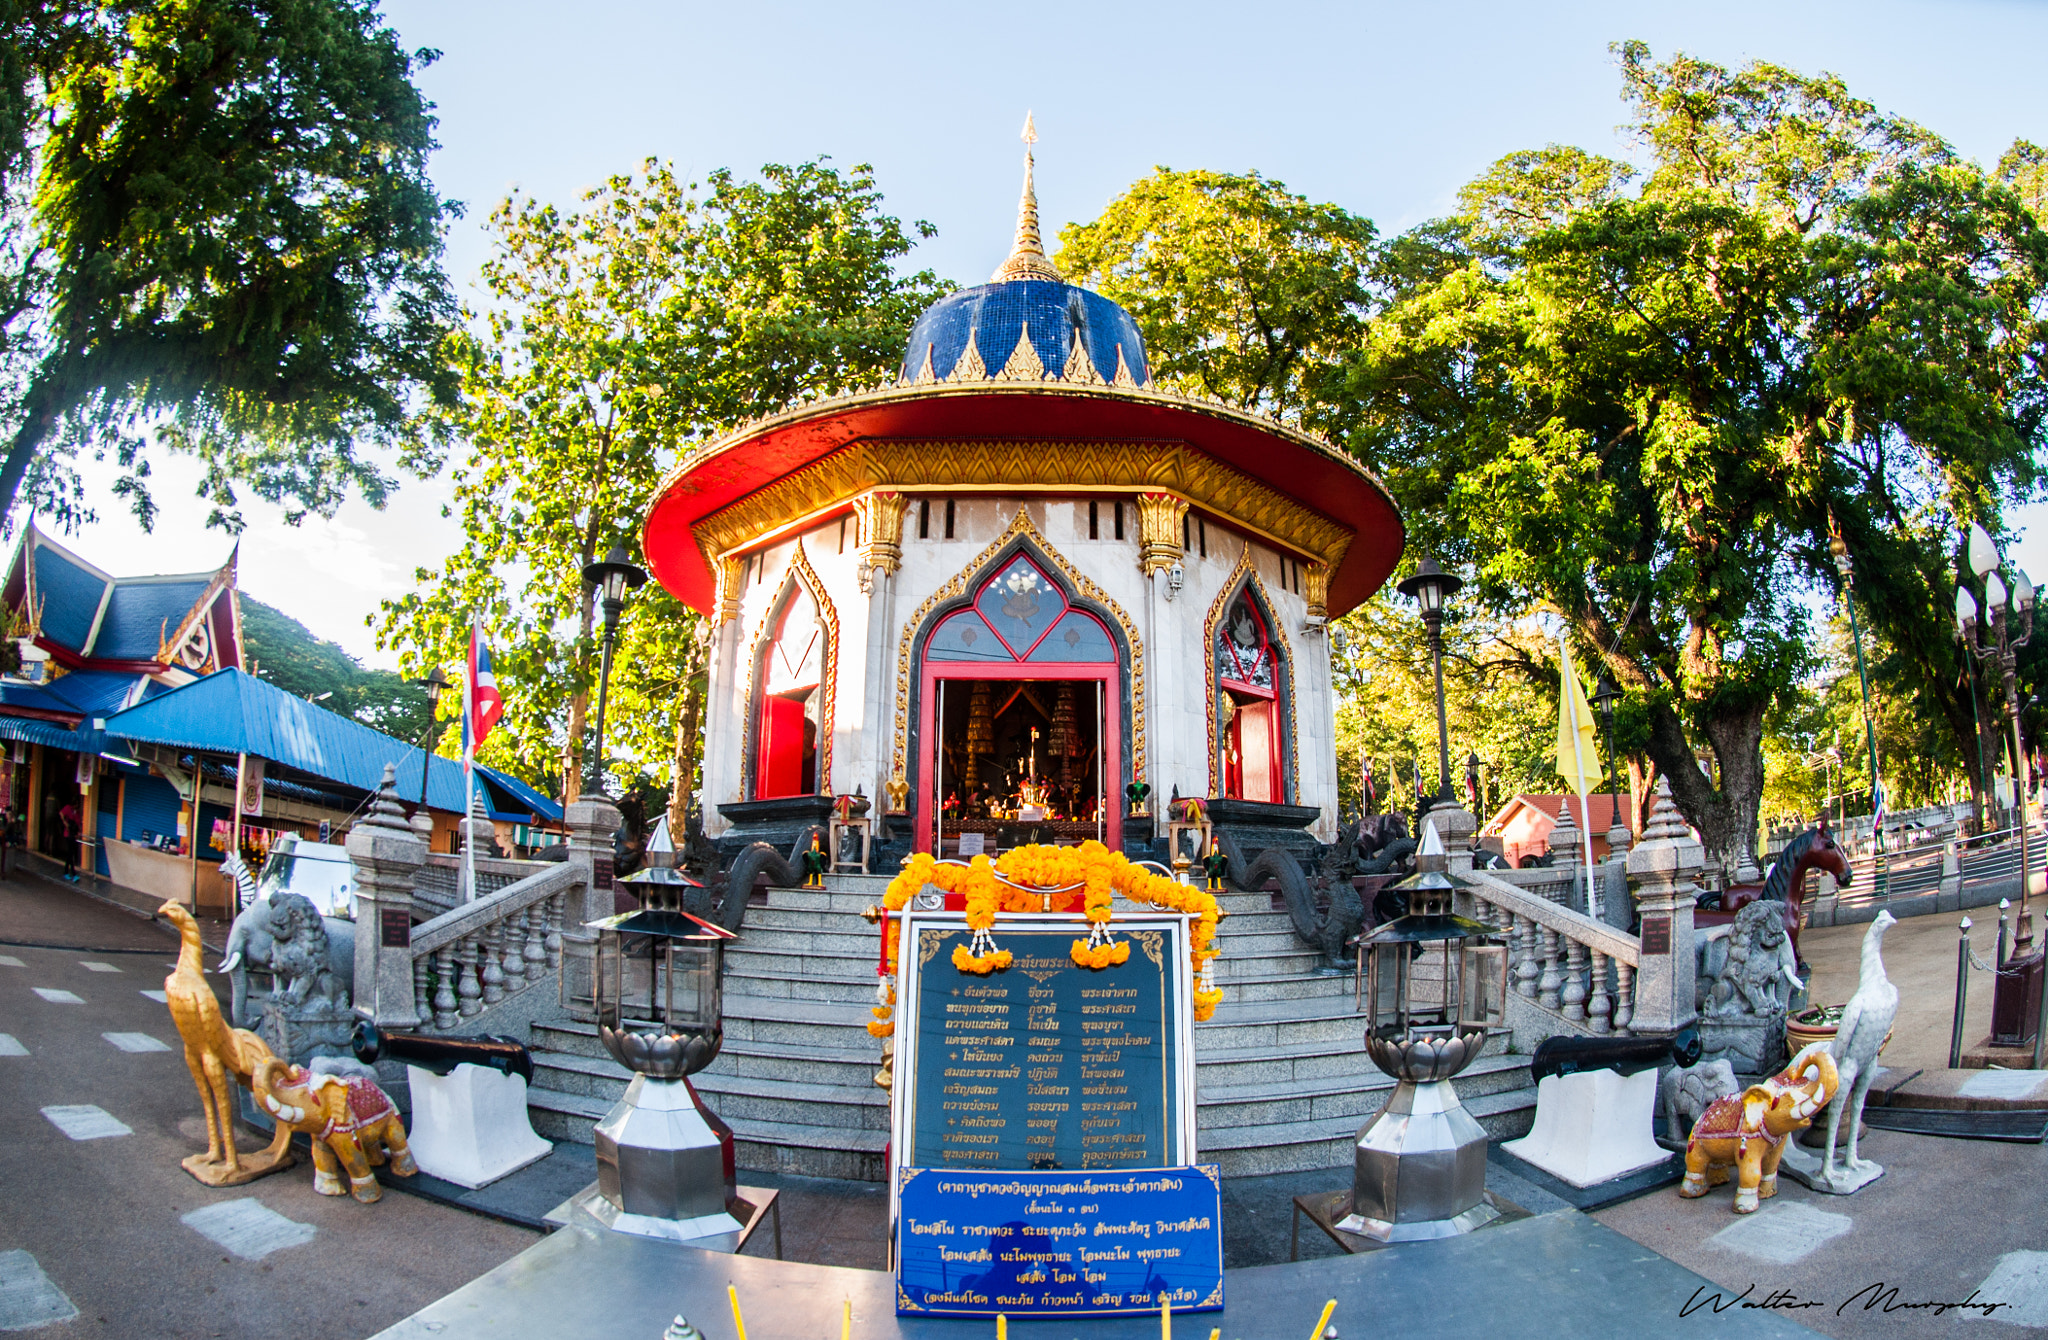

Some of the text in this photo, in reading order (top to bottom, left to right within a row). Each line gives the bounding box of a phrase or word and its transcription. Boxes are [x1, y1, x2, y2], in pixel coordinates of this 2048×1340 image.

[1028, 983, 1054, 998] ชื่อว่า
[1081, 983, 1138, 998] พระเจ้าตาก
[1028, 999, 1057, 1015] กู้ชาติ
[1081, 1004, 1136, 1014] พระศาสนา
[945, 1014, 1124, 1033] ถวายแผ่นดิน ให้เป็น พุทธบูชา
[1027, 1036, 1061, 1047] สมณะ
[1081, 1033, 1151, 1049] พระพุทธโคดม
[1027, 1048, 1063, 1063] คงถ้วน
[1081, 1048, 1120, 1062] ห้าพันปี
[1027, 1067, 1058, 1081] ปฏิบัติ
[943, 1081, 1128, 1097] เจริญสมถะ วิปัสสนา พ่อชื่นชม
[943, 1099, 1137, 1112] ถวายบังคม รอยบาท พระศาสดา
[960, 1112, 1120, 1130] คิดถึงพ่อ พ่ออยู่ คู่กับเจ้า
[943, 1132, 999, 1144] ชาติของเรา
[1081, 1130, 1146, 1147] คู่พระศาสนา
[942, 1150, 999, 1163] พุทธศาสนา
[1081, 1204, 1099, 1214] จบ)
[908, 1219, 955, 1236] โอมสิโน
[962, 1226, 1015, 1237] ราชาเทวะ
[1000, 1247, 1072, 1267] นะโมพุทธายะ
[1078, 1246, 1130, 1263] โอมนะโม
[1137, 1247, 1181, 1264] พุทธายะ
[1051, 1268, 1077, 1284] โอม
[1082, 1267, 1107, 1283] โอม
[996, 1292, 1034, 1305] ชนะภัย
[1041, 1291, 1084, 1306] ก้าวหน้า
[1092, 1293, 1122, 1307] เจริญ
[1129, 1293, 1150, 1304] รวย
